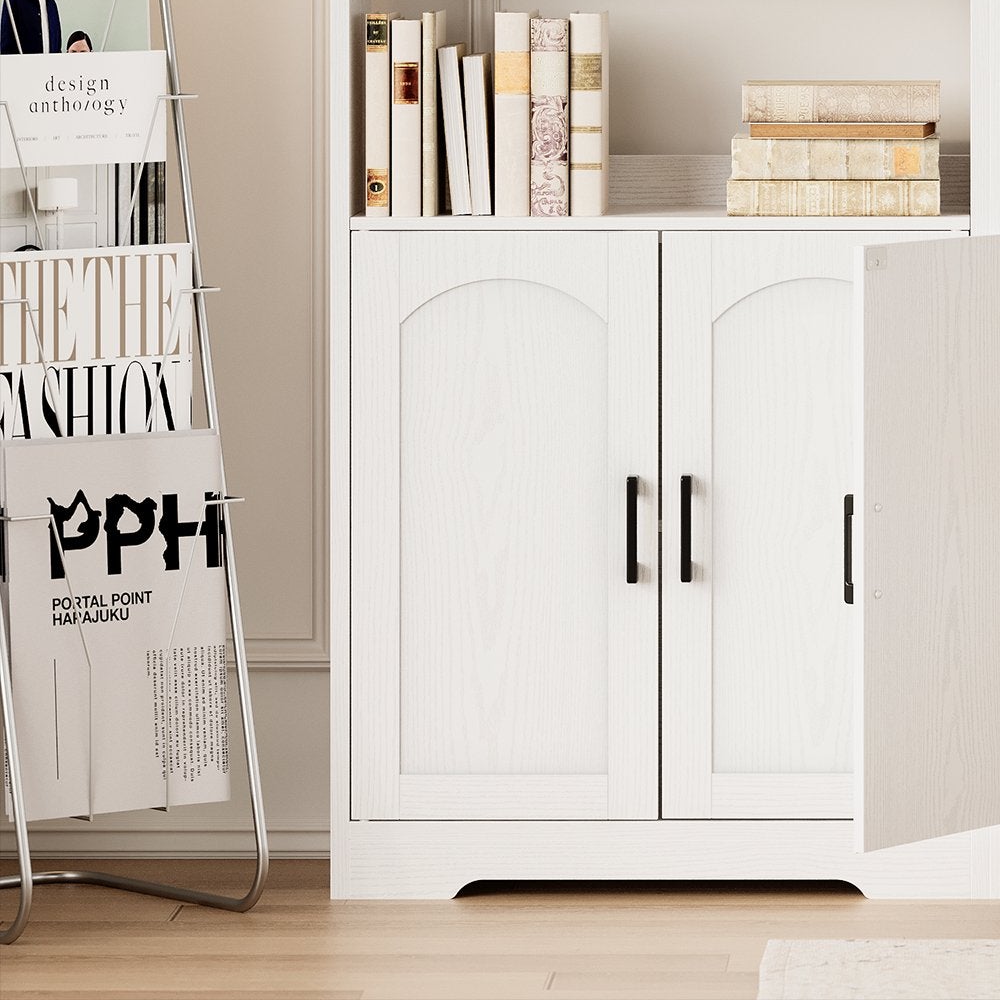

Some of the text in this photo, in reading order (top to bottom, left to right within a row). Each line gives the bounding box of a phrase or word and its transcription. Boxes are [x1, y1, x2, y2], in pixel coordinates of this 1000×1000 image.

[45, 75, 110, 95] design
[29, 95, 128, 116] anthology
[83, 252, 180, 360] THE
[52, 591, 152, 610] PORTAL POINT
